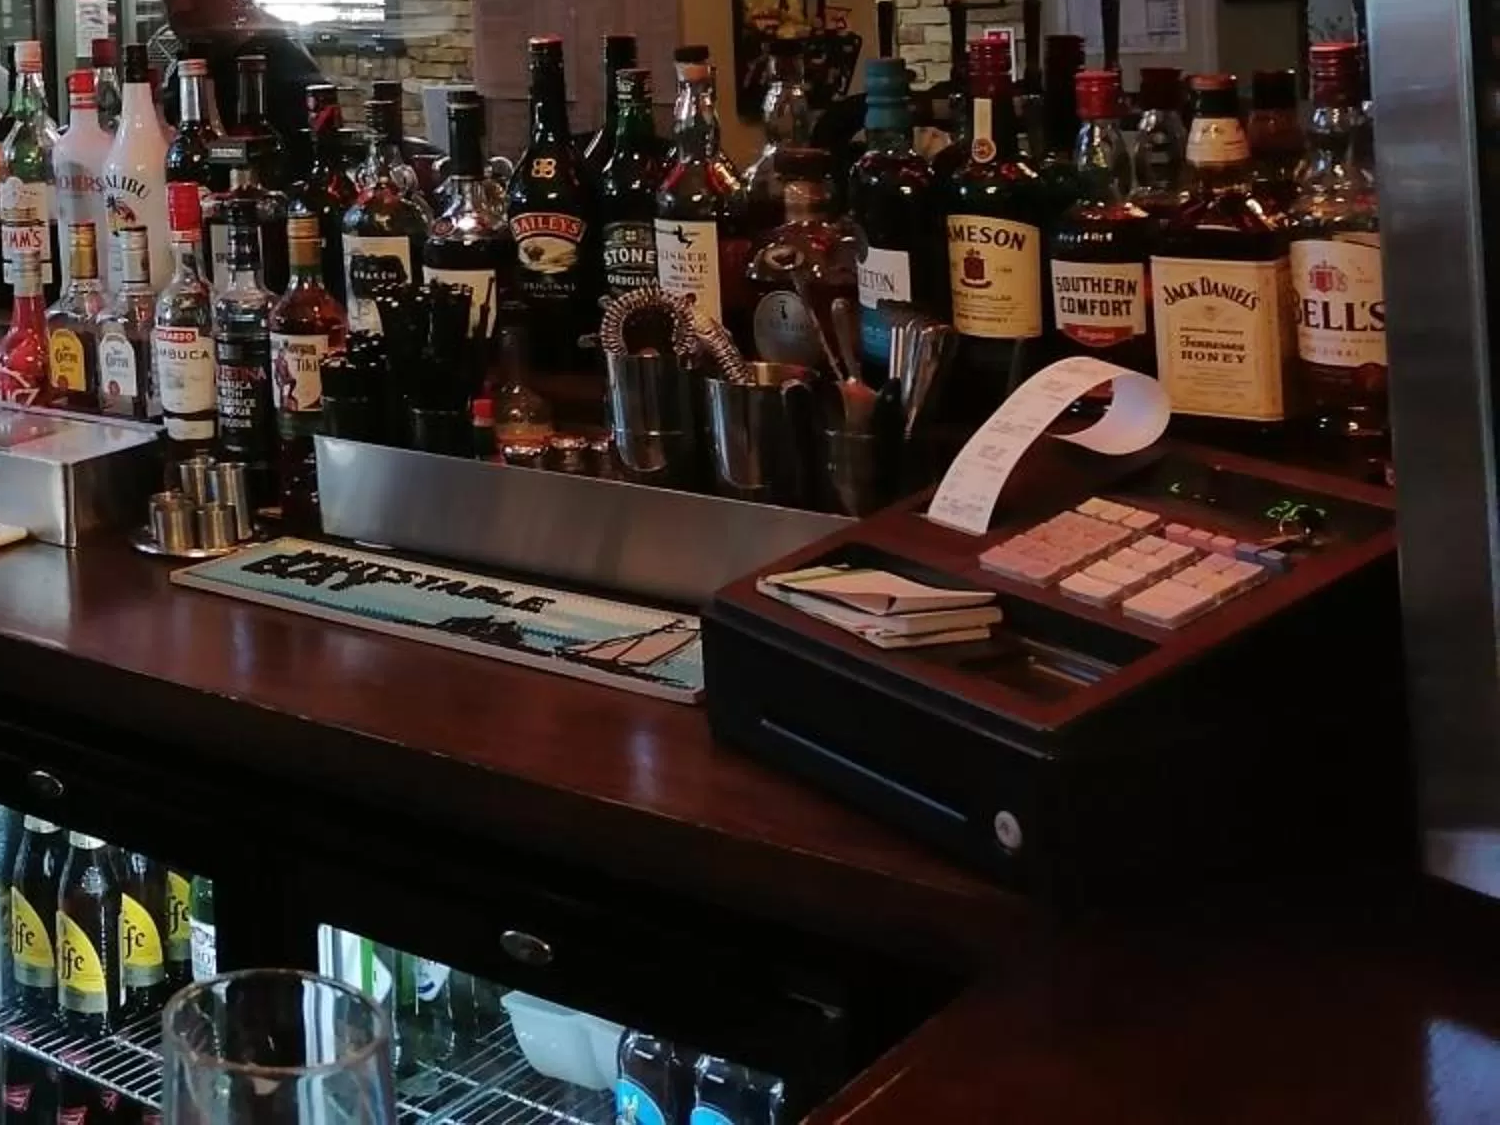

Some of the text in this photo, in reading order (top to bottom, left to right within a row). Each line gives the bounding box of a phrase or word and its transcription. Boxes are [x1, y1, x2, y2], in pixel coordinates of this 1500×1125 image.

[105, 174, 149, 201] ALIBU
[948, 223, 1028, 252] AMESON
[1055, 276, 1138, 296] SOUTHERN
[1162, 275, 1261, 312] JACK DANIEL'S
[1060, 296, 1133, 316] COMFORT
[1180, 350, 1247, 364] HONEY
